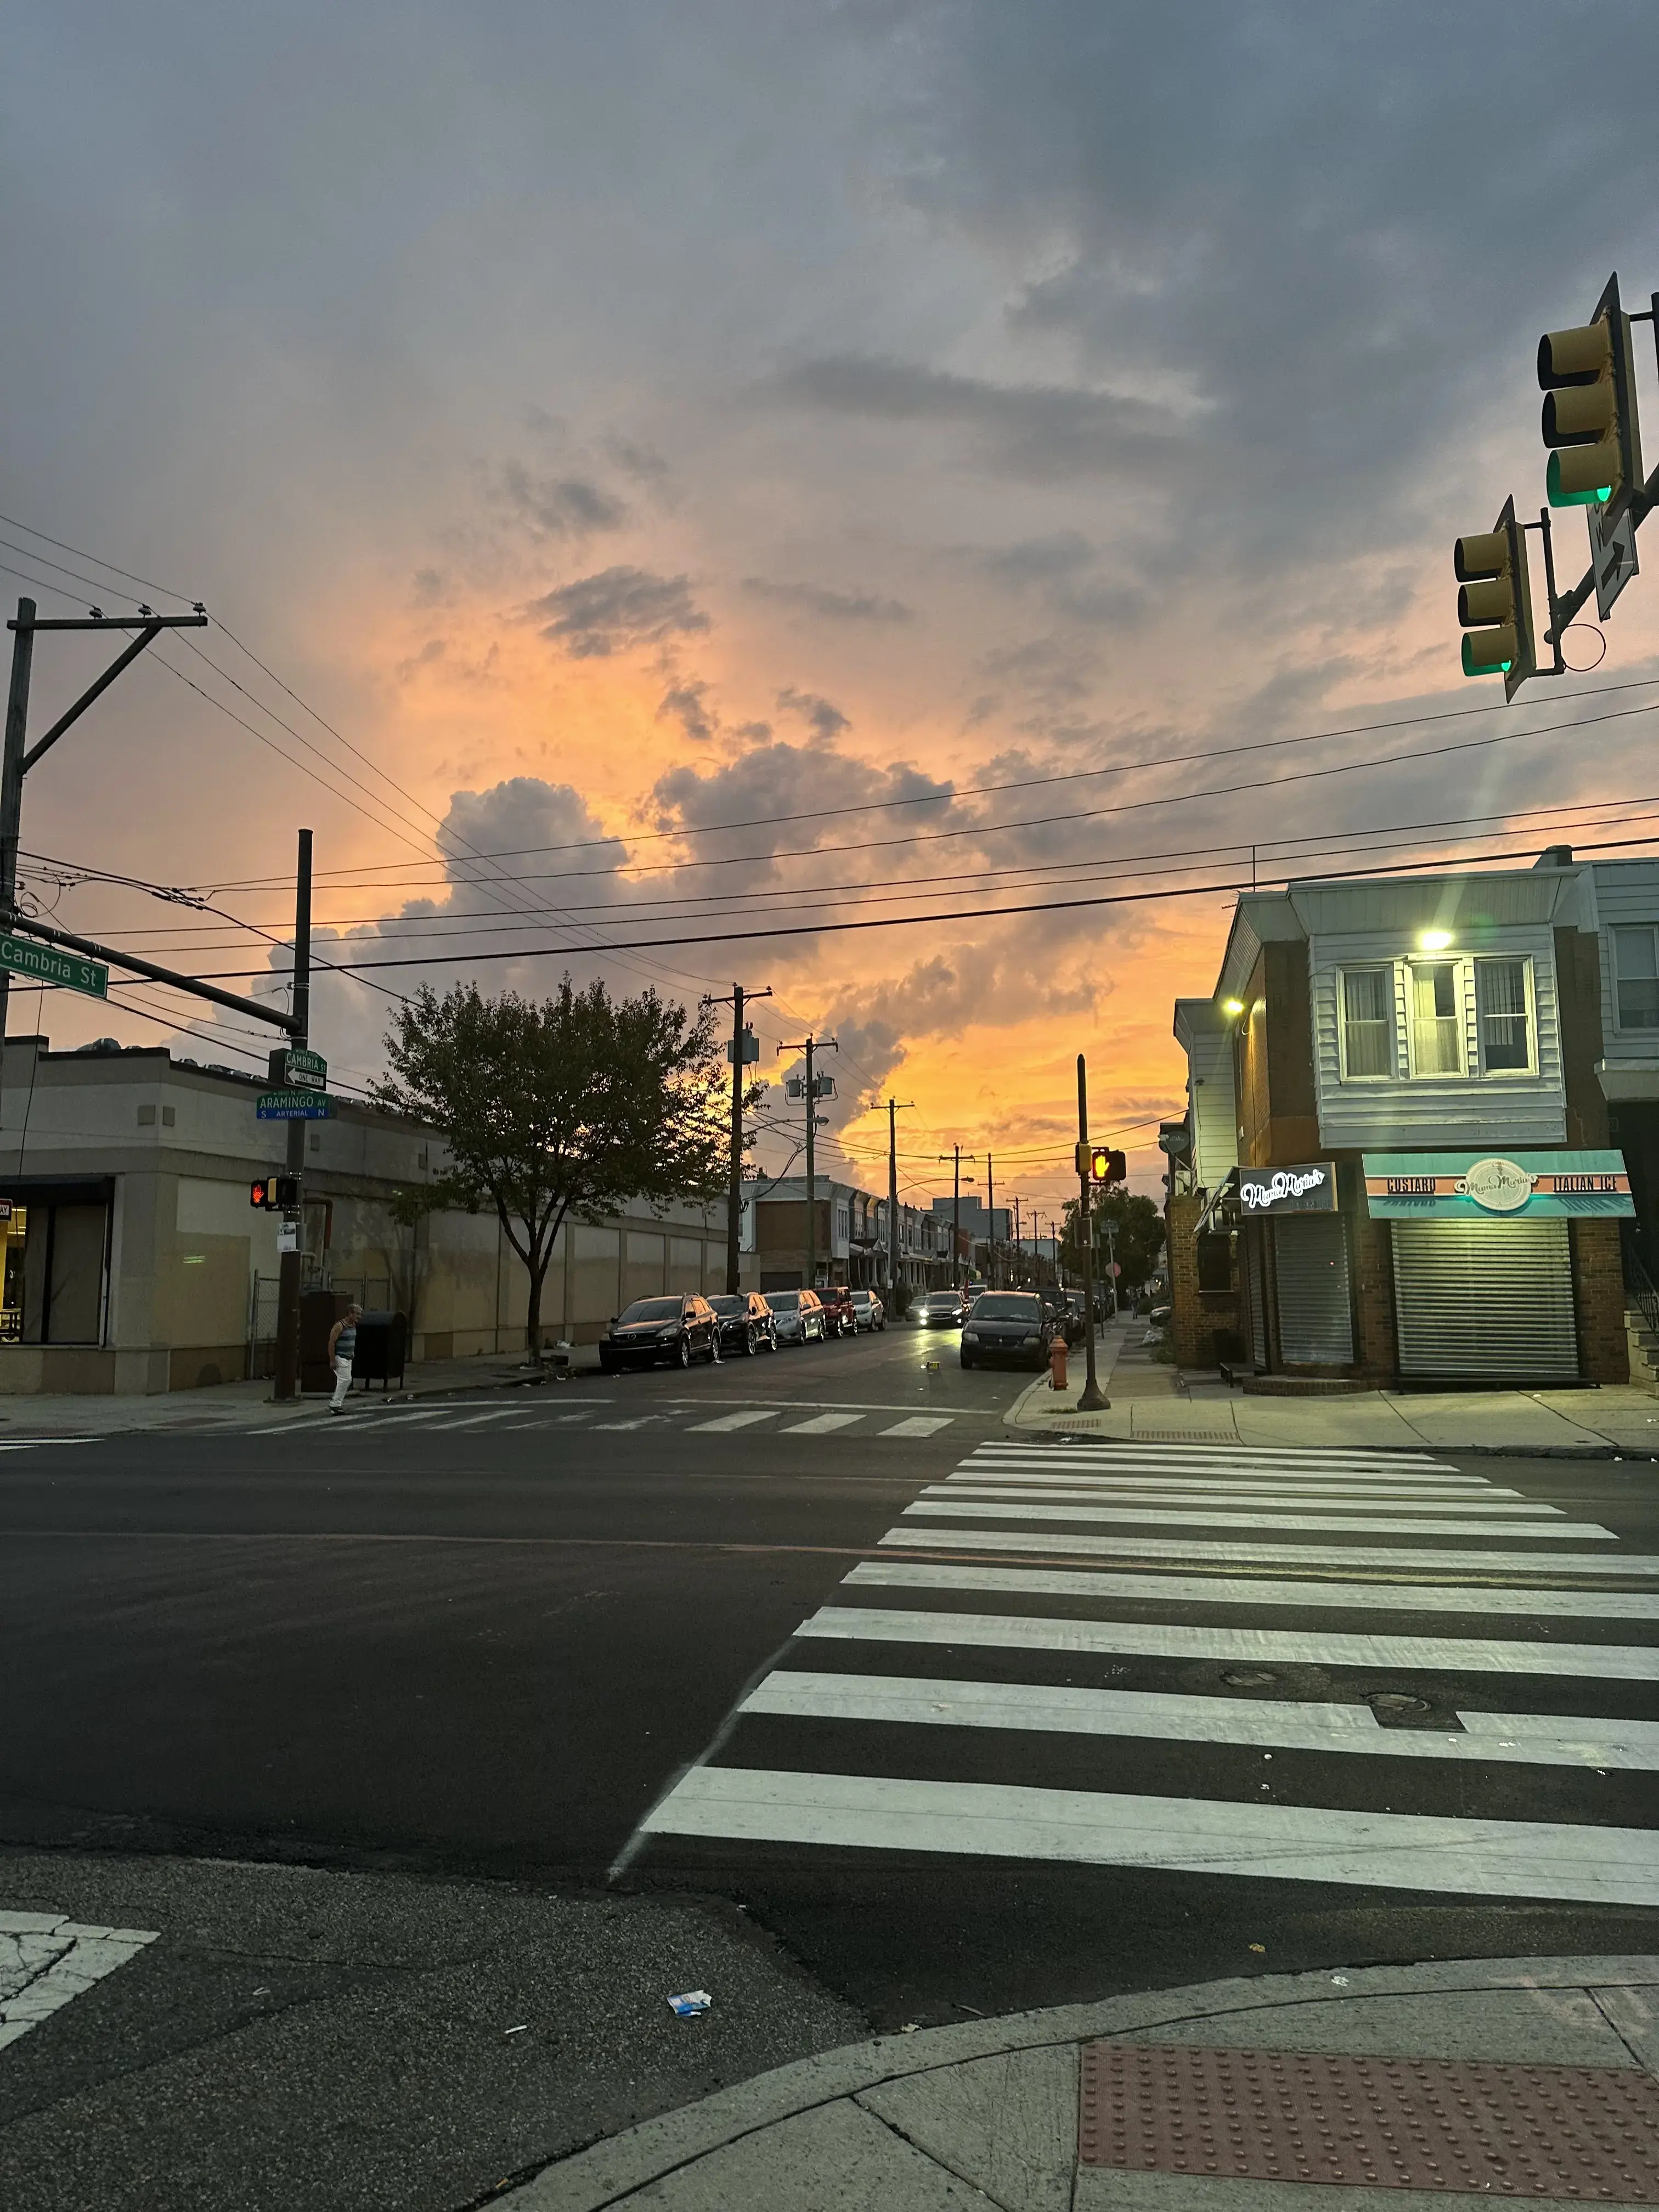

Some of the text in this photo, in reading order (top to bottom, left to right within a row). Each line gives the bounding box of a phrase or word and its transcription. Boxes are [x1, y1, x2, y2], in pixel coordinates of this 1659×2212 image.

[2, 941, 96, 986] Cambria St
[286, 1052, 326, 1072] CAMBRIA ST
[298, 1073, 321, 1085] ONE WAY
[259, 1096, 313, 1108] ARAMINGO
[318, 1108, 324, 1116] N
[1387, 1178, 1436, 1192] CUSTARD
[1454, 1175, 1538, 1195] Mama Maria's
[1554, 1176, 1617, 1191] ITALIAN ICE
